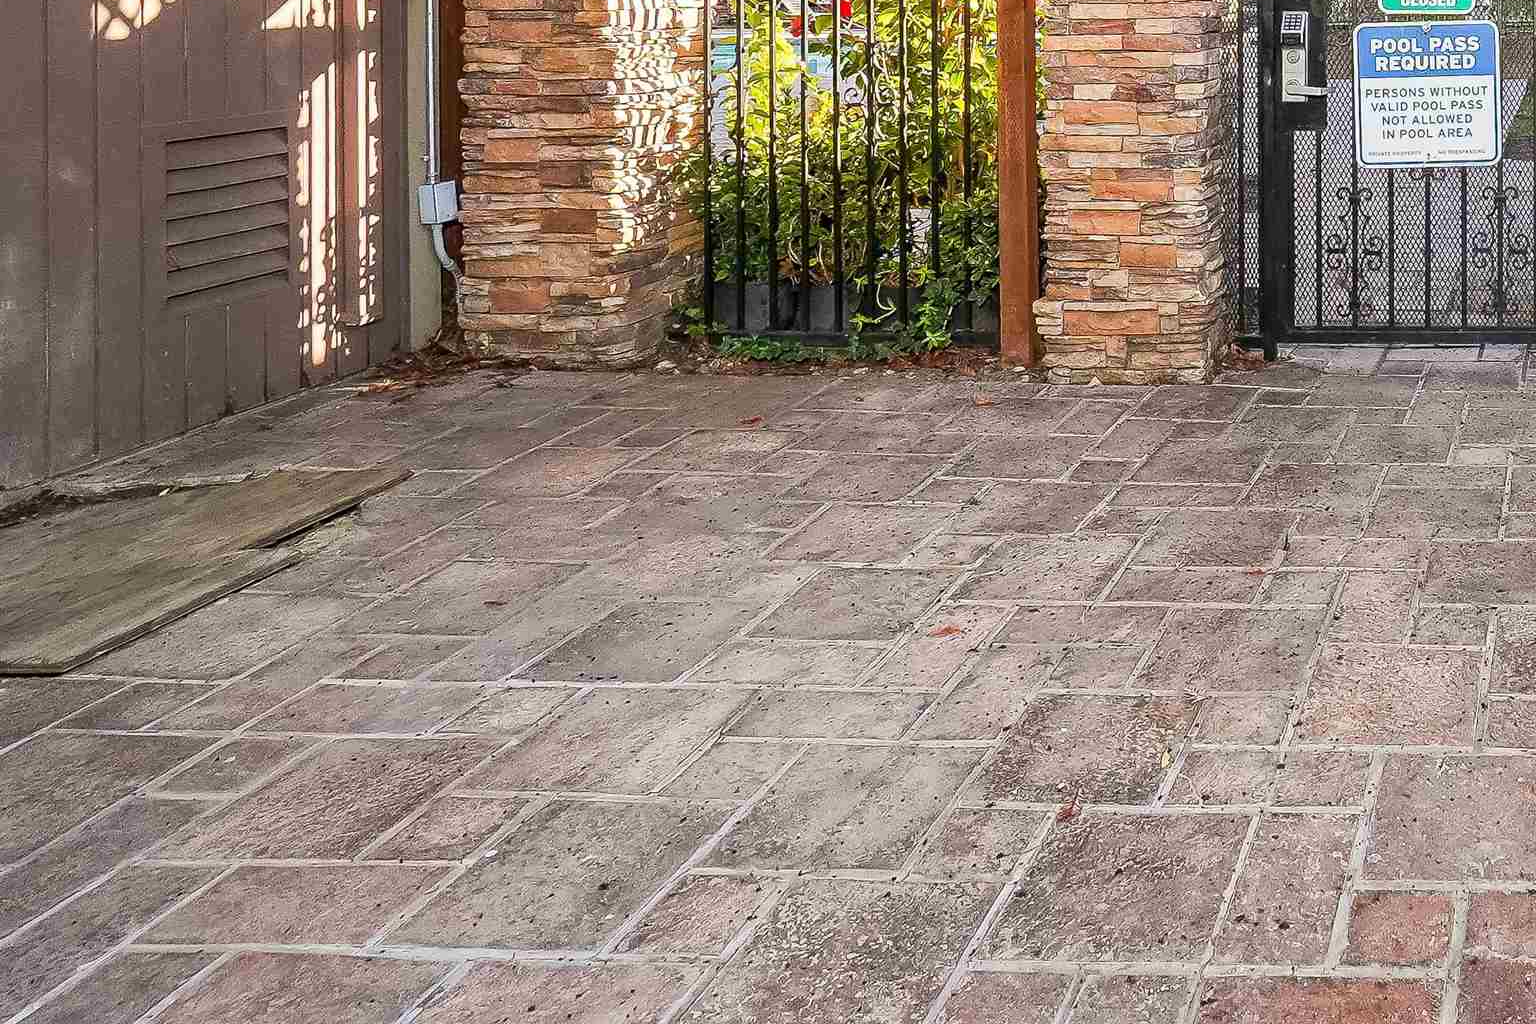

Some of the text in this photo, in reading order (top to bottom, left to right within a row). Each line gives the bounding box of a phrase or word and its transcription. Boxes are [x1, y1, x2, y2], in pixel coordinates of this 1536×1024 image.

[1370, 36, 1480, 54] POOL PASS
[1375, 54, 1476, 72] REQUIRED
[1365, 86, 1488, 98] PERSONS WITHOUT
[1370, 100, 1484, 112] VALID POOL PASS
[1382, 114, 1473, 125] NOT ALLOWED
[1382, 127, 1473, 139] IN POOL AREA
